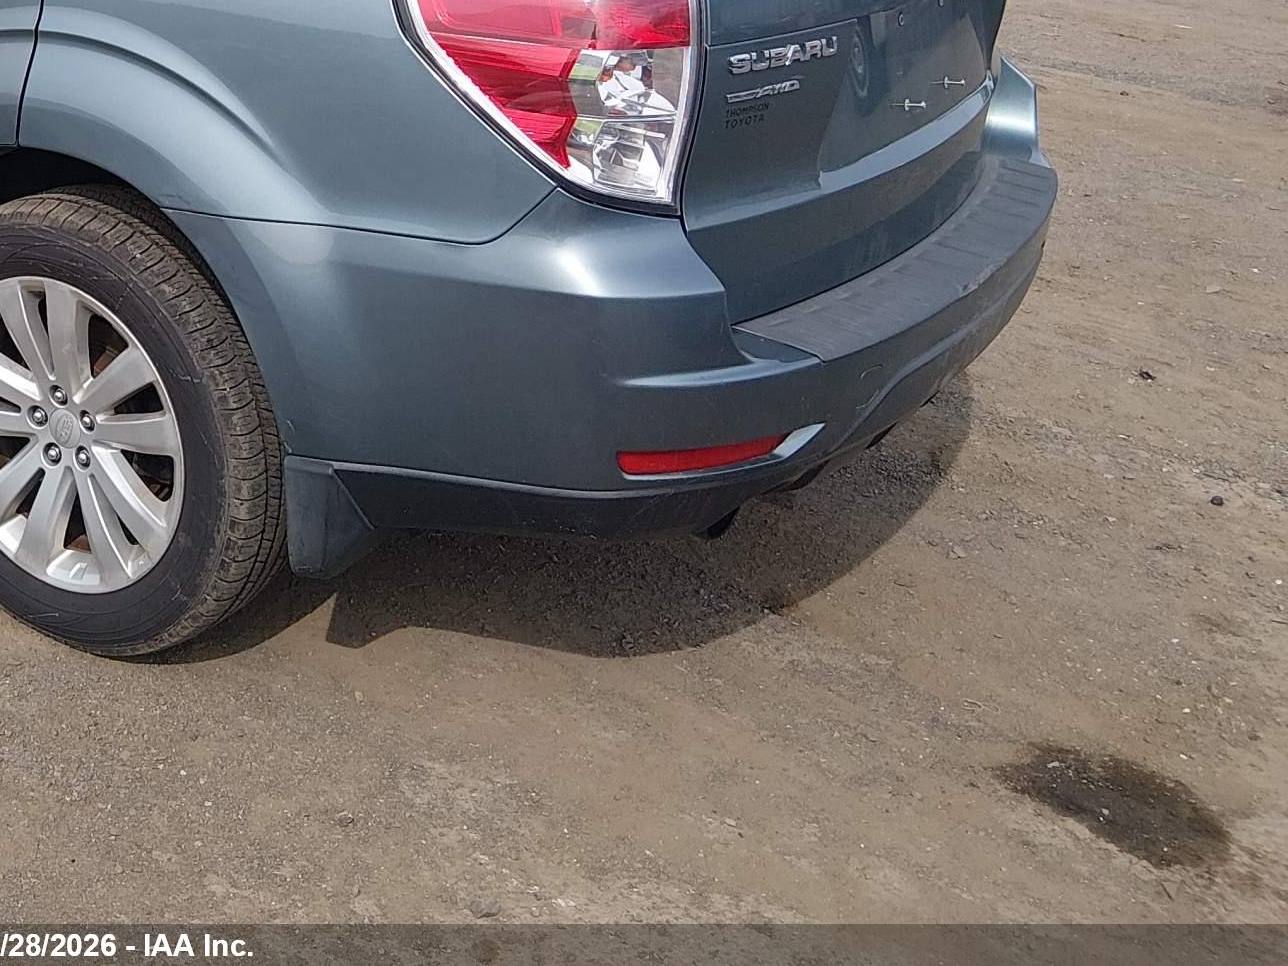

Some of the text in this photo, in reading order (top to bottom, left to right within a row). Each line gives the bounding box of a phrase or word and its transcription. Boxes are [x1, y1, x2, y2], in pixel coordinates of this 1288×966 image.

[728, 36, 837, 74] SUBARU
[726, 101, 770, 118] THOMPSON
[725, 114, 765, 129] TOYOTA
